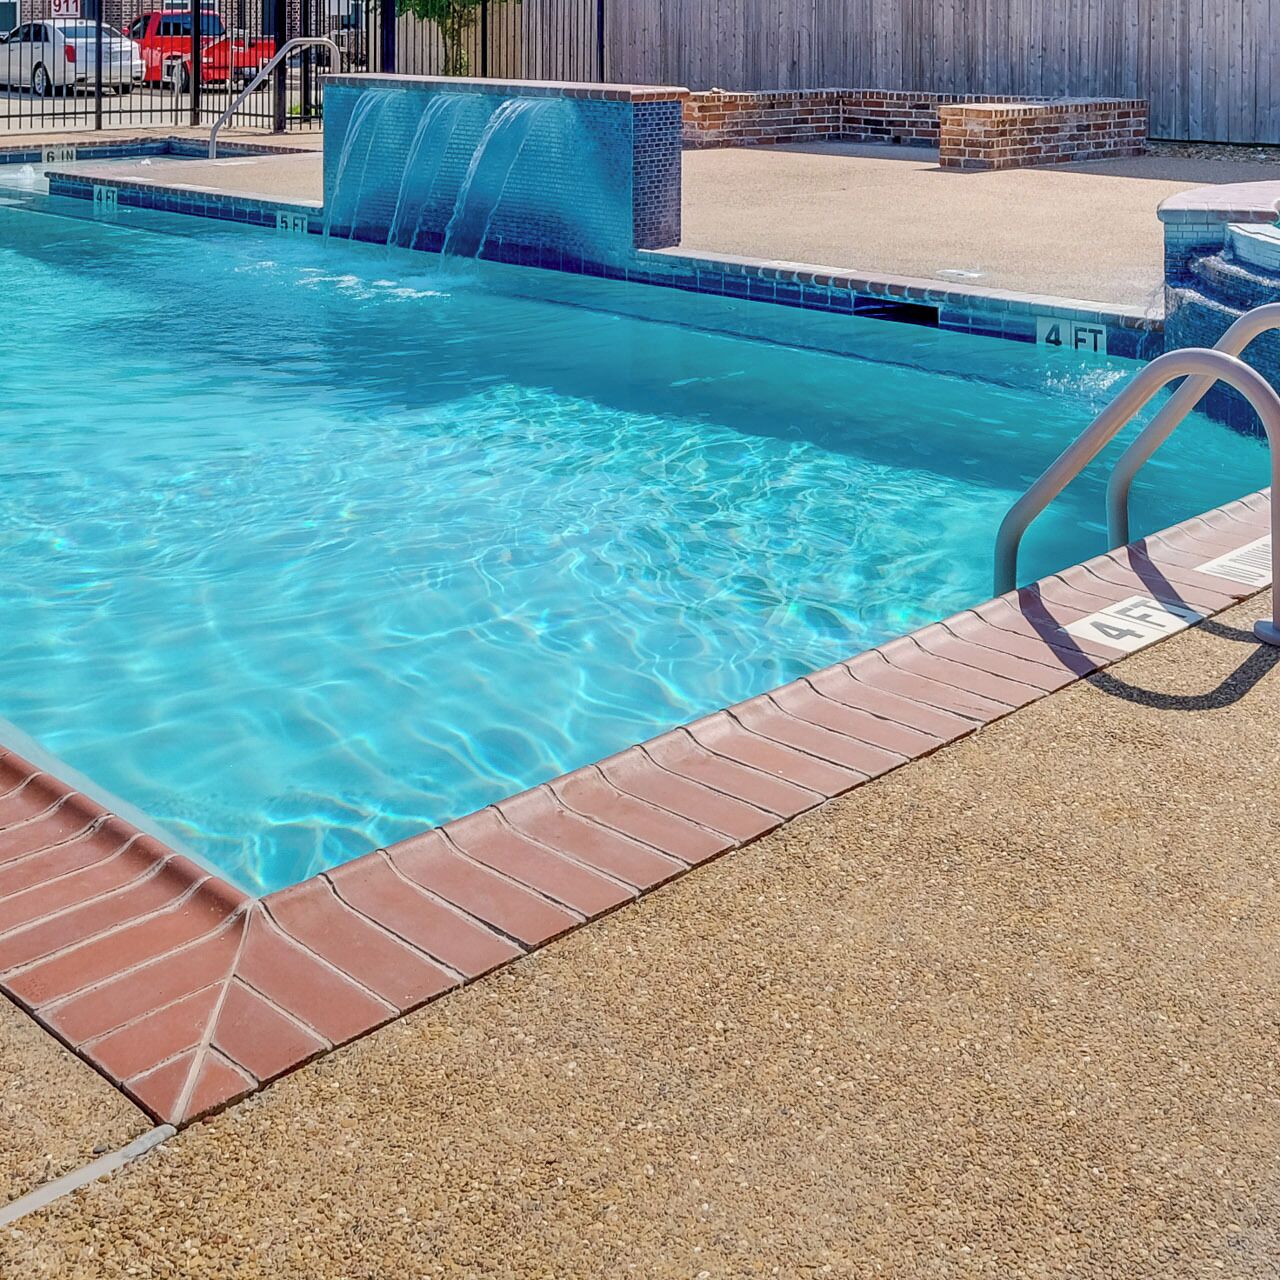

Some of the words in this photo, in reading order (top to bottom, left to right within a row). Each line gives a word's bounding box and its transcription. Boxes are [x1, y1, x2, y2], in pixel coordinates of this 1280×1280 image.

[46, 151, 55, 162] 6
[61, 149, 74, 161] IN
[96, 188, 102, 202] 4
[106, 190, 116, 203] FT
[280, 216, 288, 230] 5
[292, 216, 306, 232] FT
[1045, 324, 1062, 346] 4
[1074, 326, 1104, 352] FT
[1113, 600, 1188, 628] FT
[1090, 621, 1144, 640] 4
